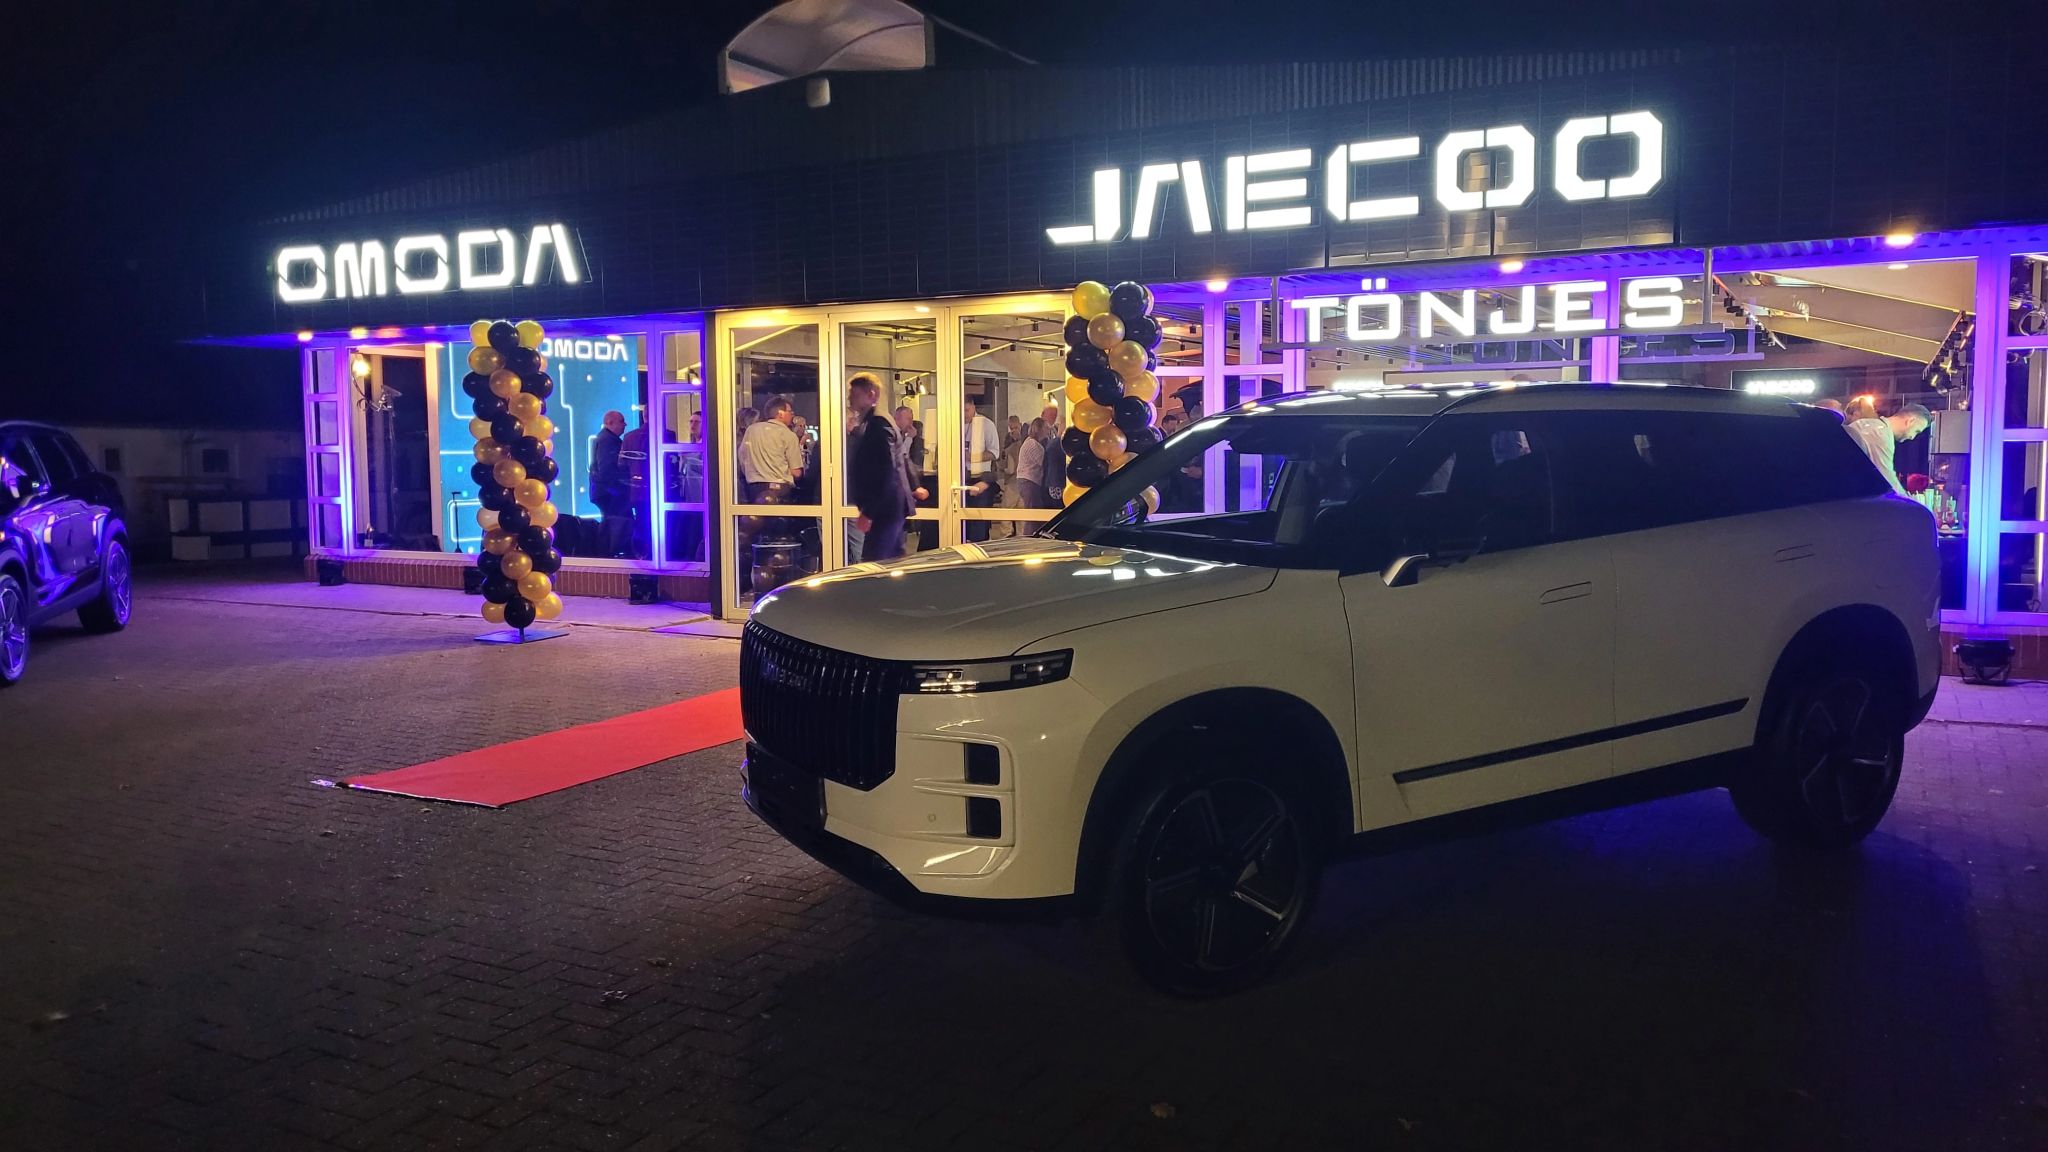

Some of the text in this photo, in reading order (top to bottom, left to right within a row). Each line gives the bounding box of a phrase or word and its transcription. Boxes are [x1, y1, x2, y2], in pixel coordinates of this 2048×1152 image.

[1046, 110, 1663, 245] JAECOO
[276, 223, 578, 302] OMODA
[1289, 276, 1685, 343] TÖNJES
[540, 337, 629, 362] OMODA
